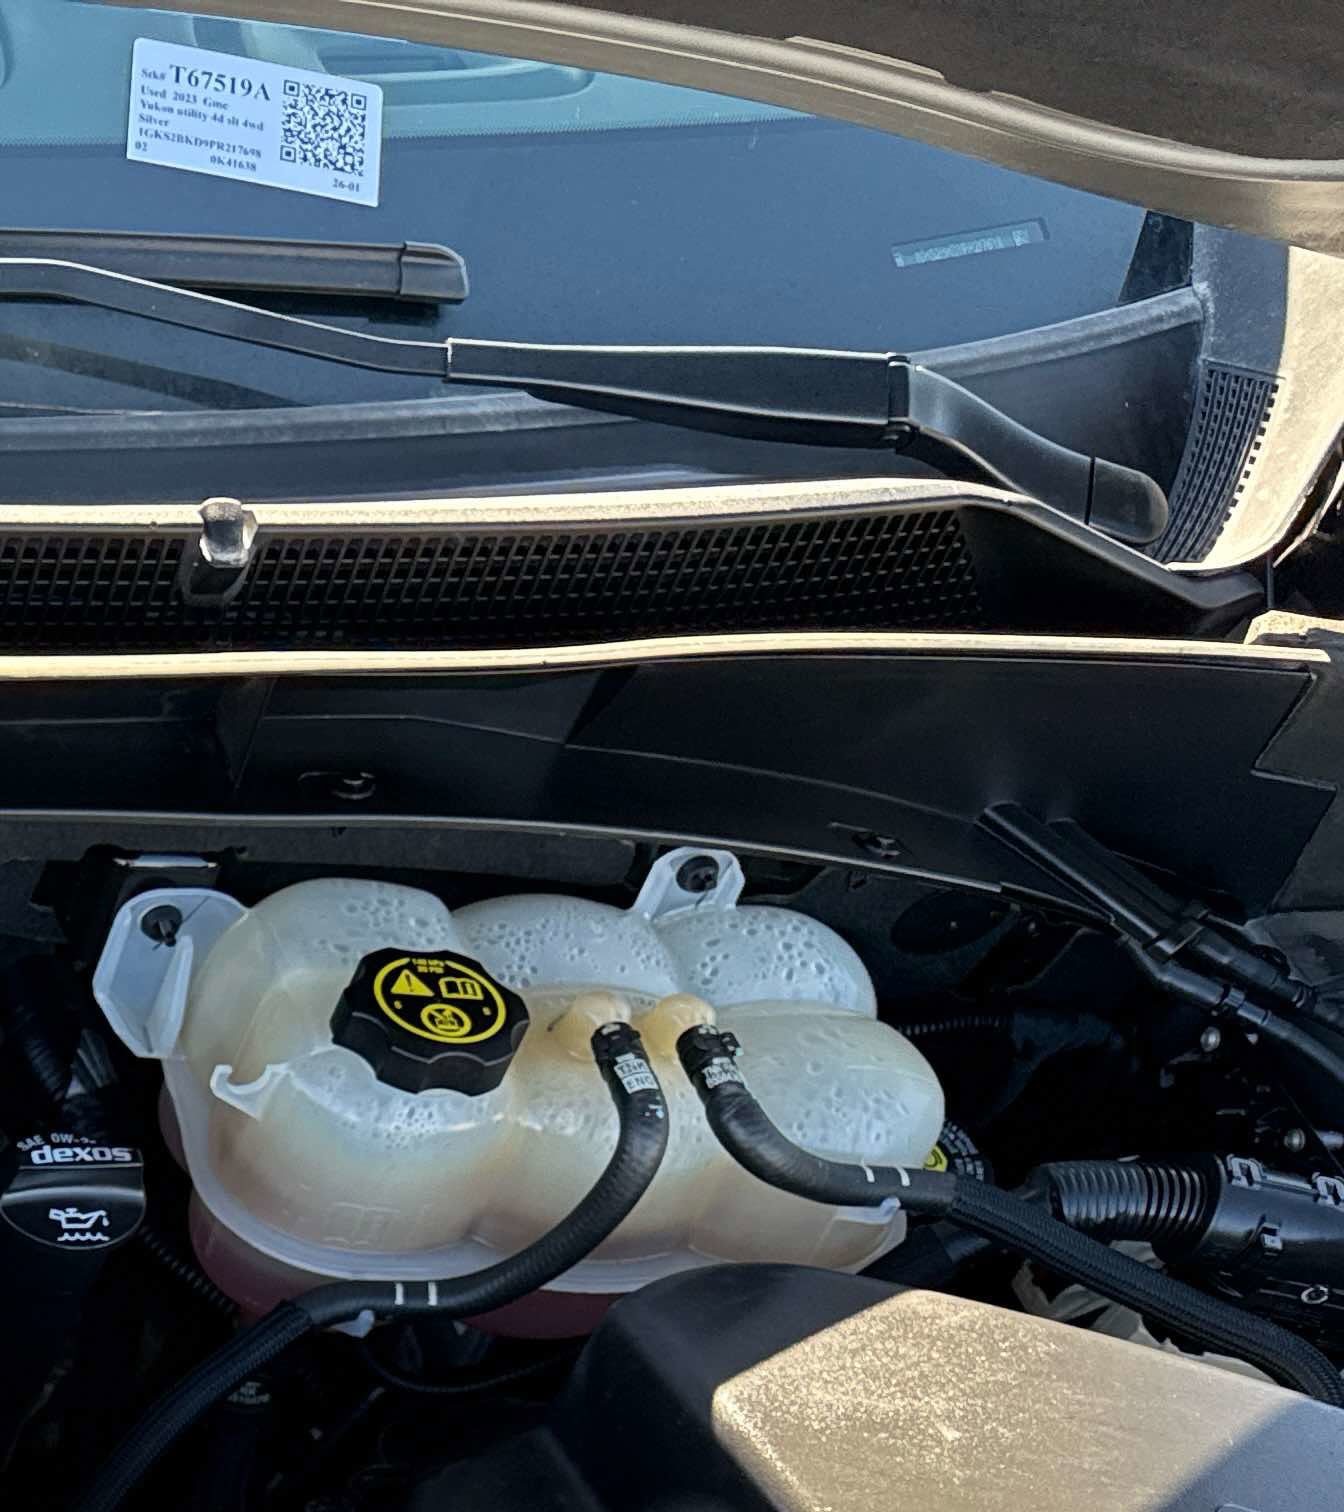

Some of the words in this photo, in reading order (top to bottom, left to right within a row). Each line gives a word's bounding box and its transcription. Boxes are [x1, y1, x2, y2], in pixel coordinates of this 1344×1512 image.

[169, 64, 271, 101] T67519A
[140, 84, 167, 99] Used
[173, 91, 198, 104] 2023
[202, 97, 229, 110] Gmc
[138, 113, 170, 127] Silver
[140, 99, 175, 113] Yukon
[177, 108, 208, 122] utility
[332, 177, 360, 193] 26-01
[16, 1135, 45, 1152] SAE
[49, 1132, 97, 1145] 0W-
[30, 1144, 133, 1165] dexos
